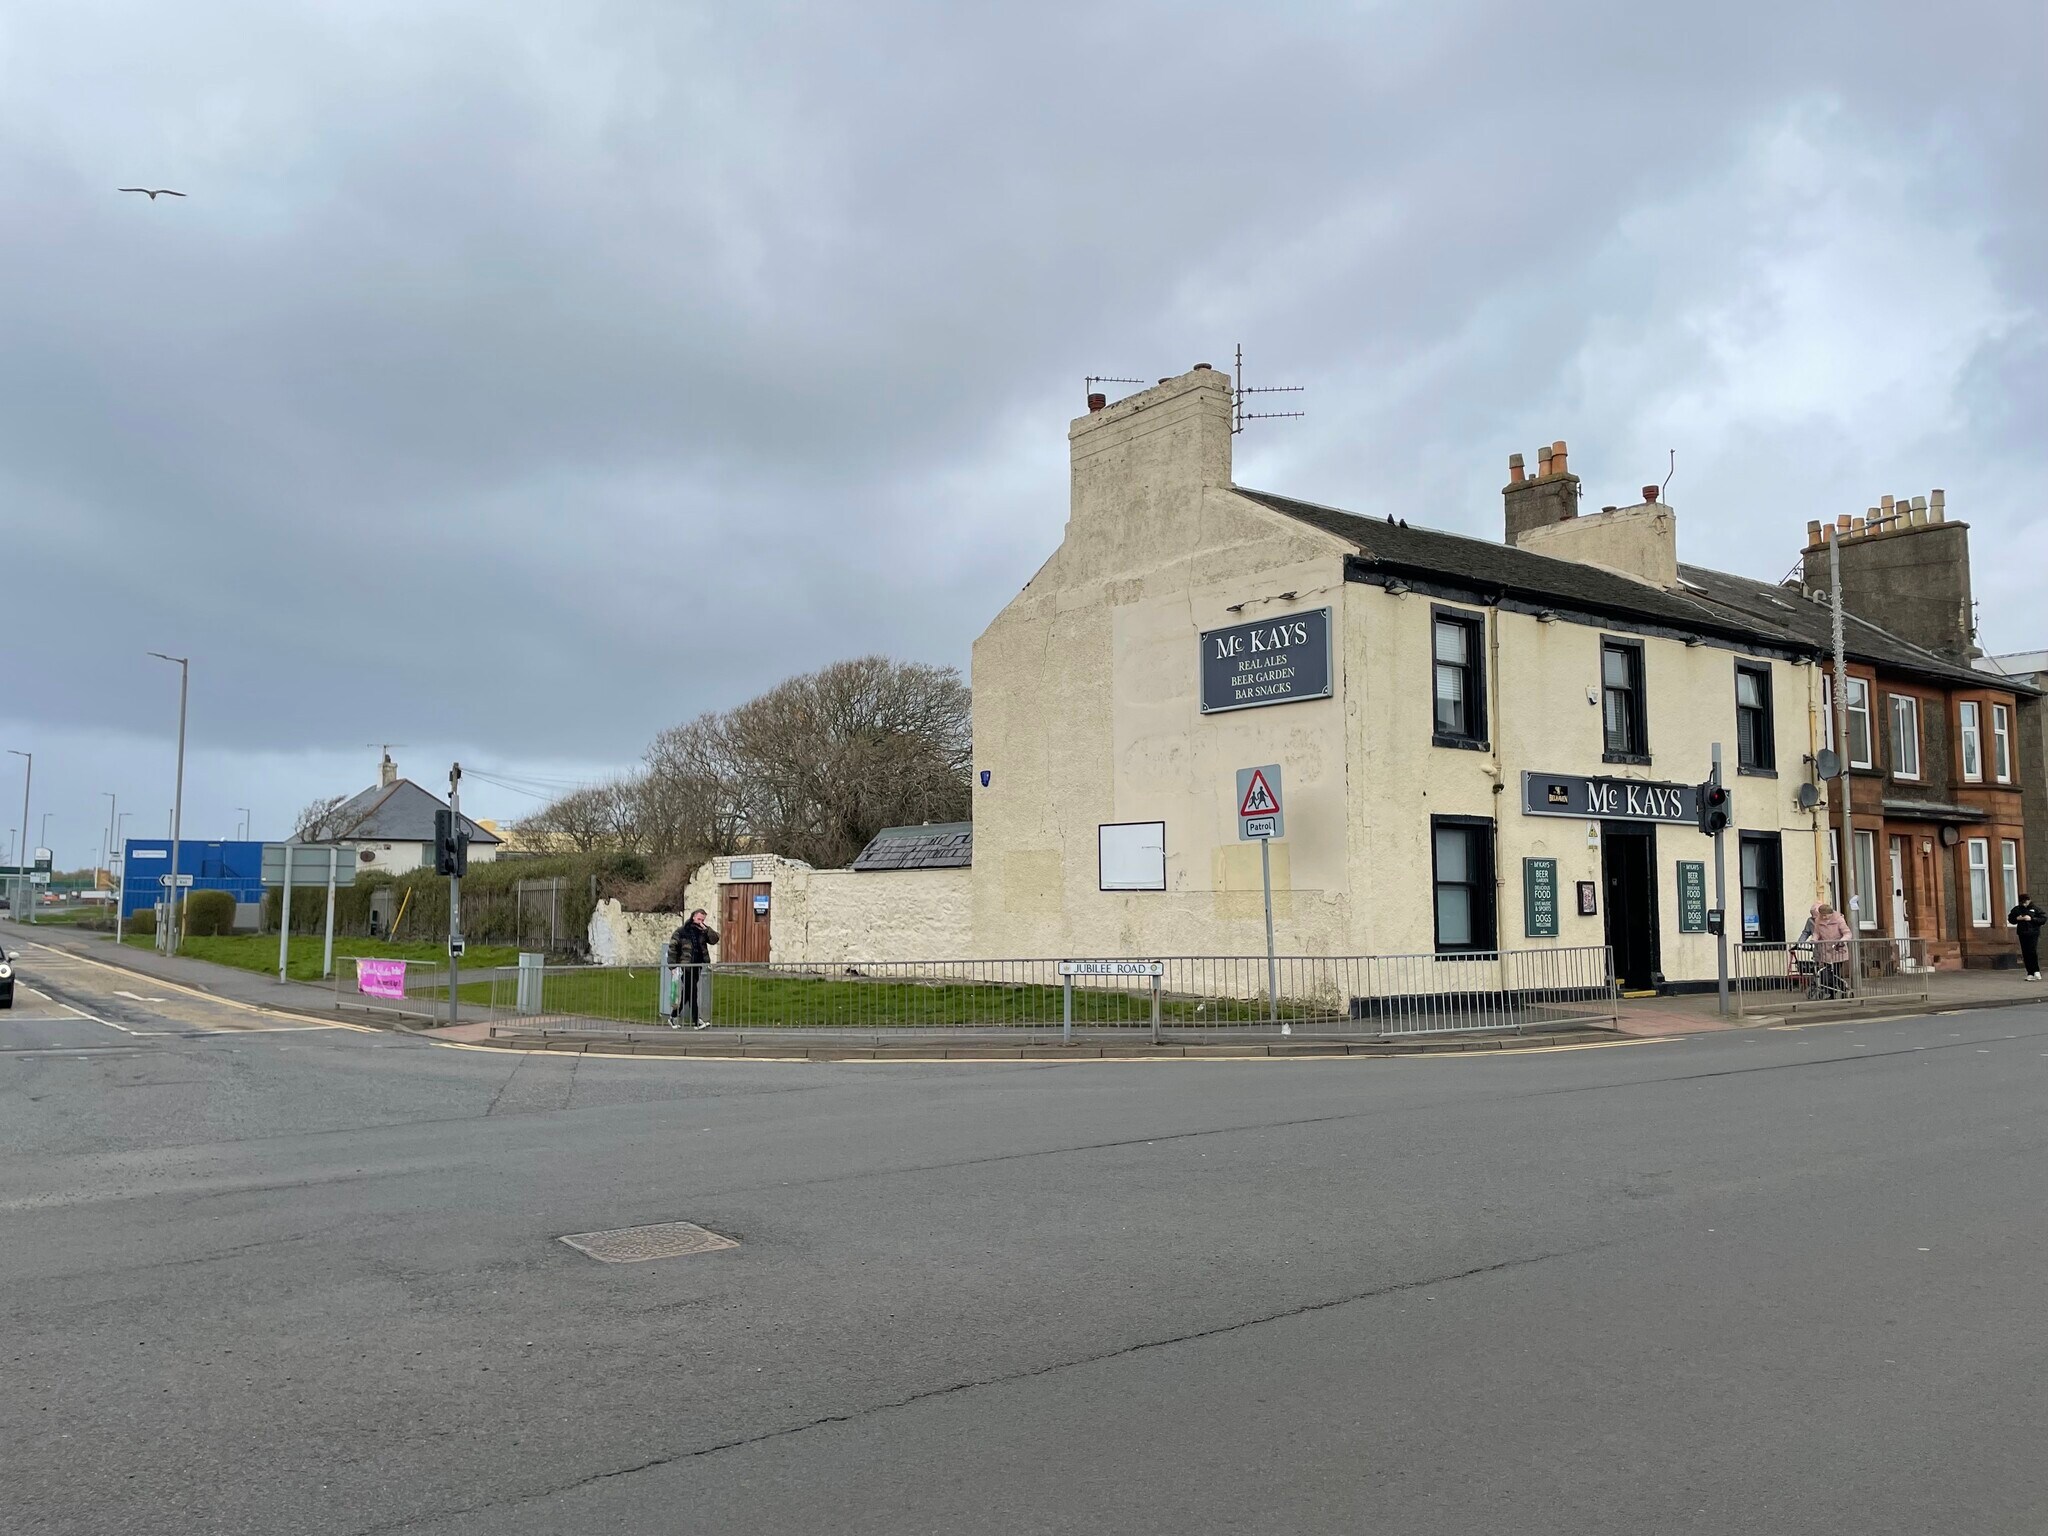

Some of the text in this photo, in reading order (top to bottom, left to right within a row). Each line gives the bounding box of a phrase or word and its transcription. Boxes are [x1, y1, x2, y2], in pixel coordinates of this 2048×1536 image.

[1250, 622, 1308, 652] KAYS
[1238, 654, 1287, 671] REAL ALES
[1231, 667, 1295, 687] BEER GARDEN
[1235, 682, 1291, 700] BAR SNACKS
[1625, 785, 1682, 818] KAYS
[1250, 822, 1271, 831] Patrol
[1535, 870, 1549, 878] BEER
[1535, 891, 1551, 899] FOOD
[1687, 890, 1701, 898] FOOD
[1536, 914, 1552, 922] DOGS
[1688, 912, 1701, 920] DOGS
[1074, 964, 1146, 973] JUBILEE ROAD
